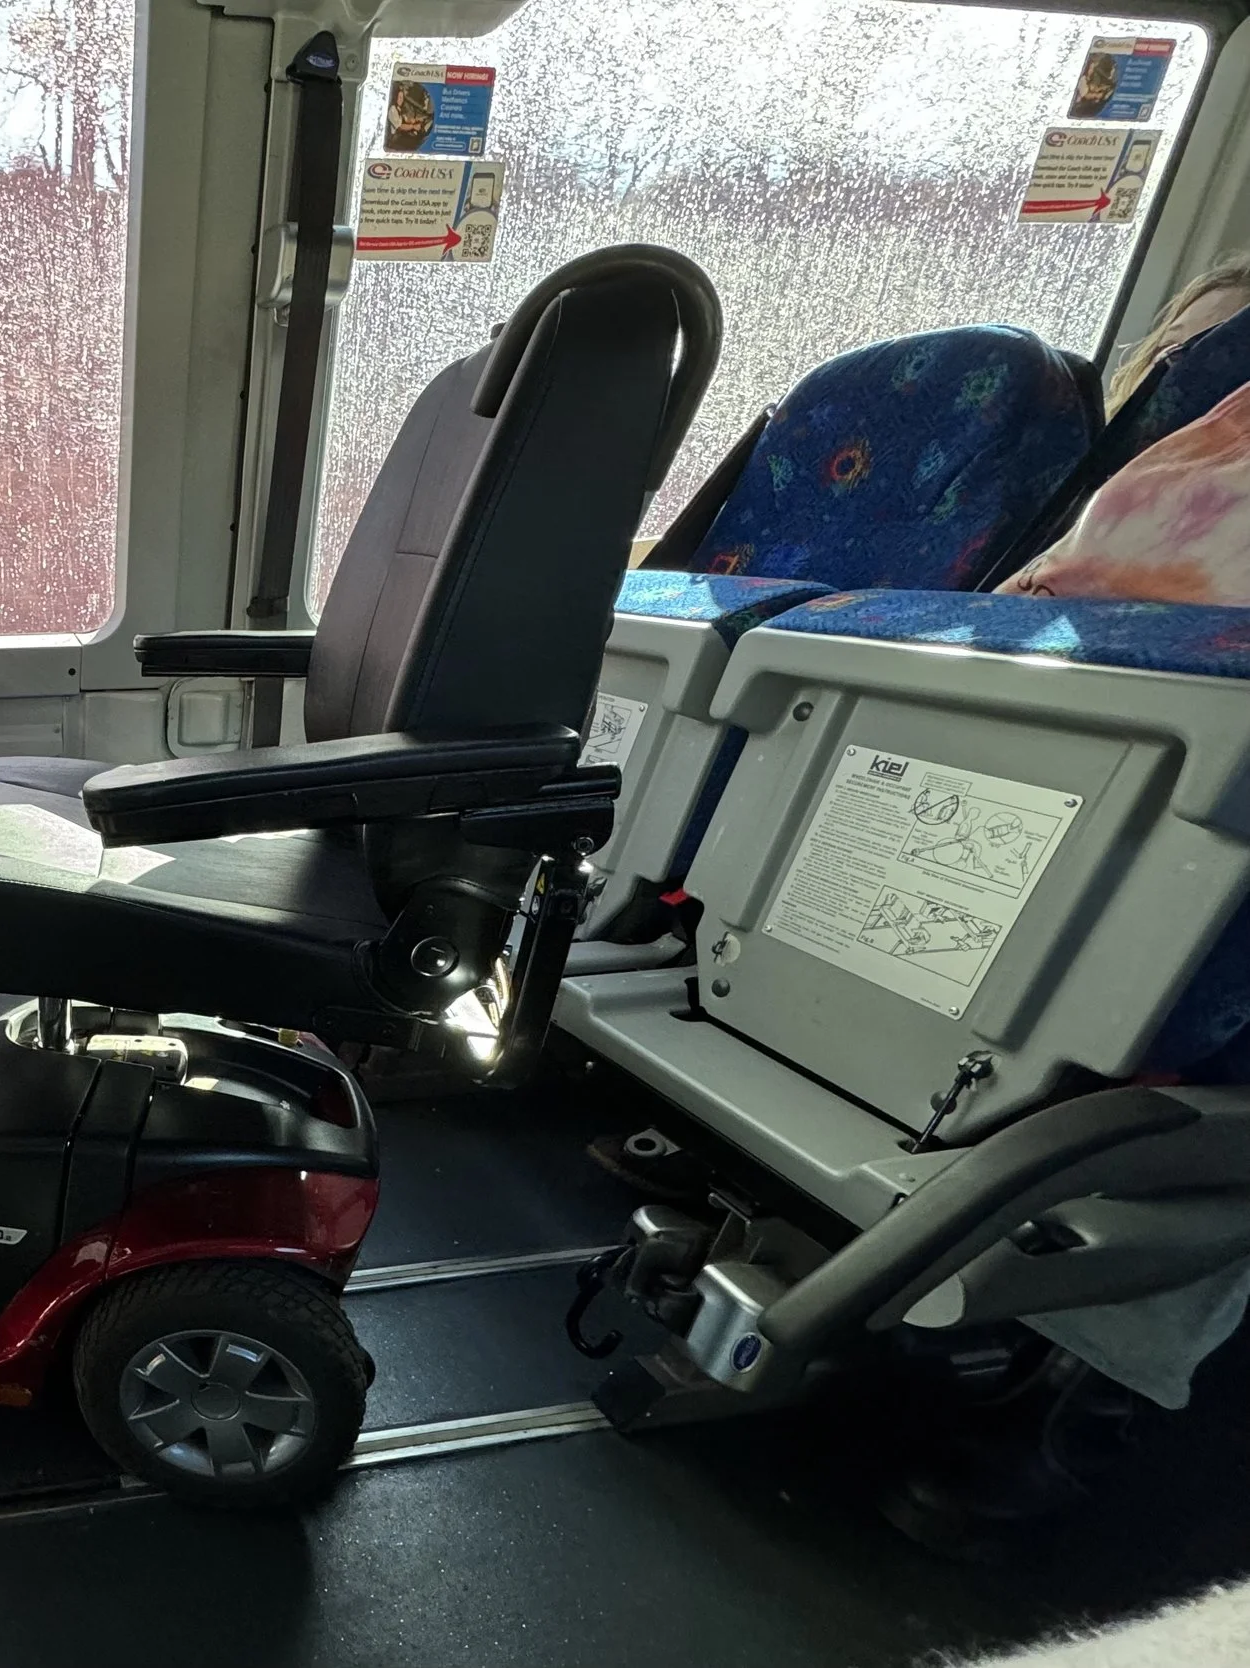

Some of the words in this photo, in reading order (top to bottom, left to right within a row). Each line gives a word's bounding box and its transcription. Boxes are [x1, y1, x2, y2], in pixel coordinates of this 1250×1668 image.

[447, 71, 462, 79] NOW
[394, 167, 429, 178] Coach
[430, 168, 454, 179] USA
[870, 755, 909, 777] kiel
[846, 779, 876, 789] SECUREMENT
[877, 787, 910, 800] INSTRUCTIONS
[886, 783, 912, 791] OCCUPANT
